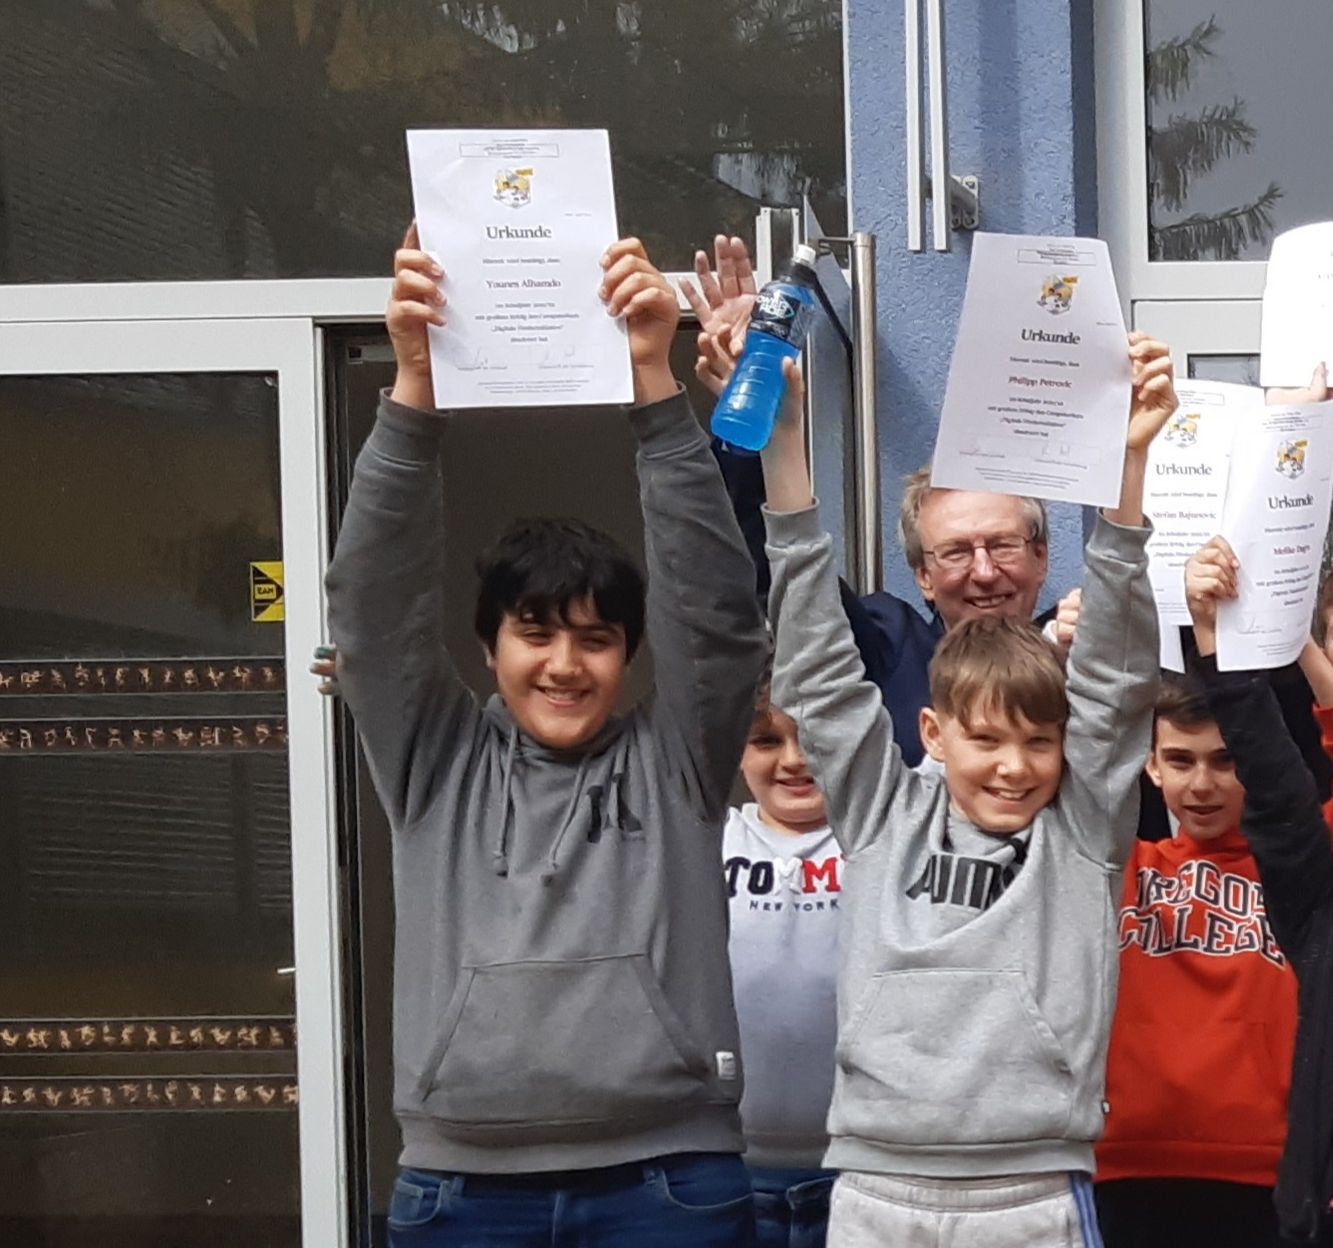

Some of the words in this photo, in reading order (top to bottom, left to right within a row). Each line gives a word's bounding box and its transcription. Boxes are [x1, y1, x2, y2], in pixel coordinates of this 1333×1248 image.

[486, 225, 552, 240] Urkunde
[1020, 328, 1081, 346] Urkunde
[1155, 463, 1213, 477] Urkunde
[724, 853, 849, 898] TOMM
[749, 899, 782, 912] NEW
[794, 899, 841, 913] YORK
